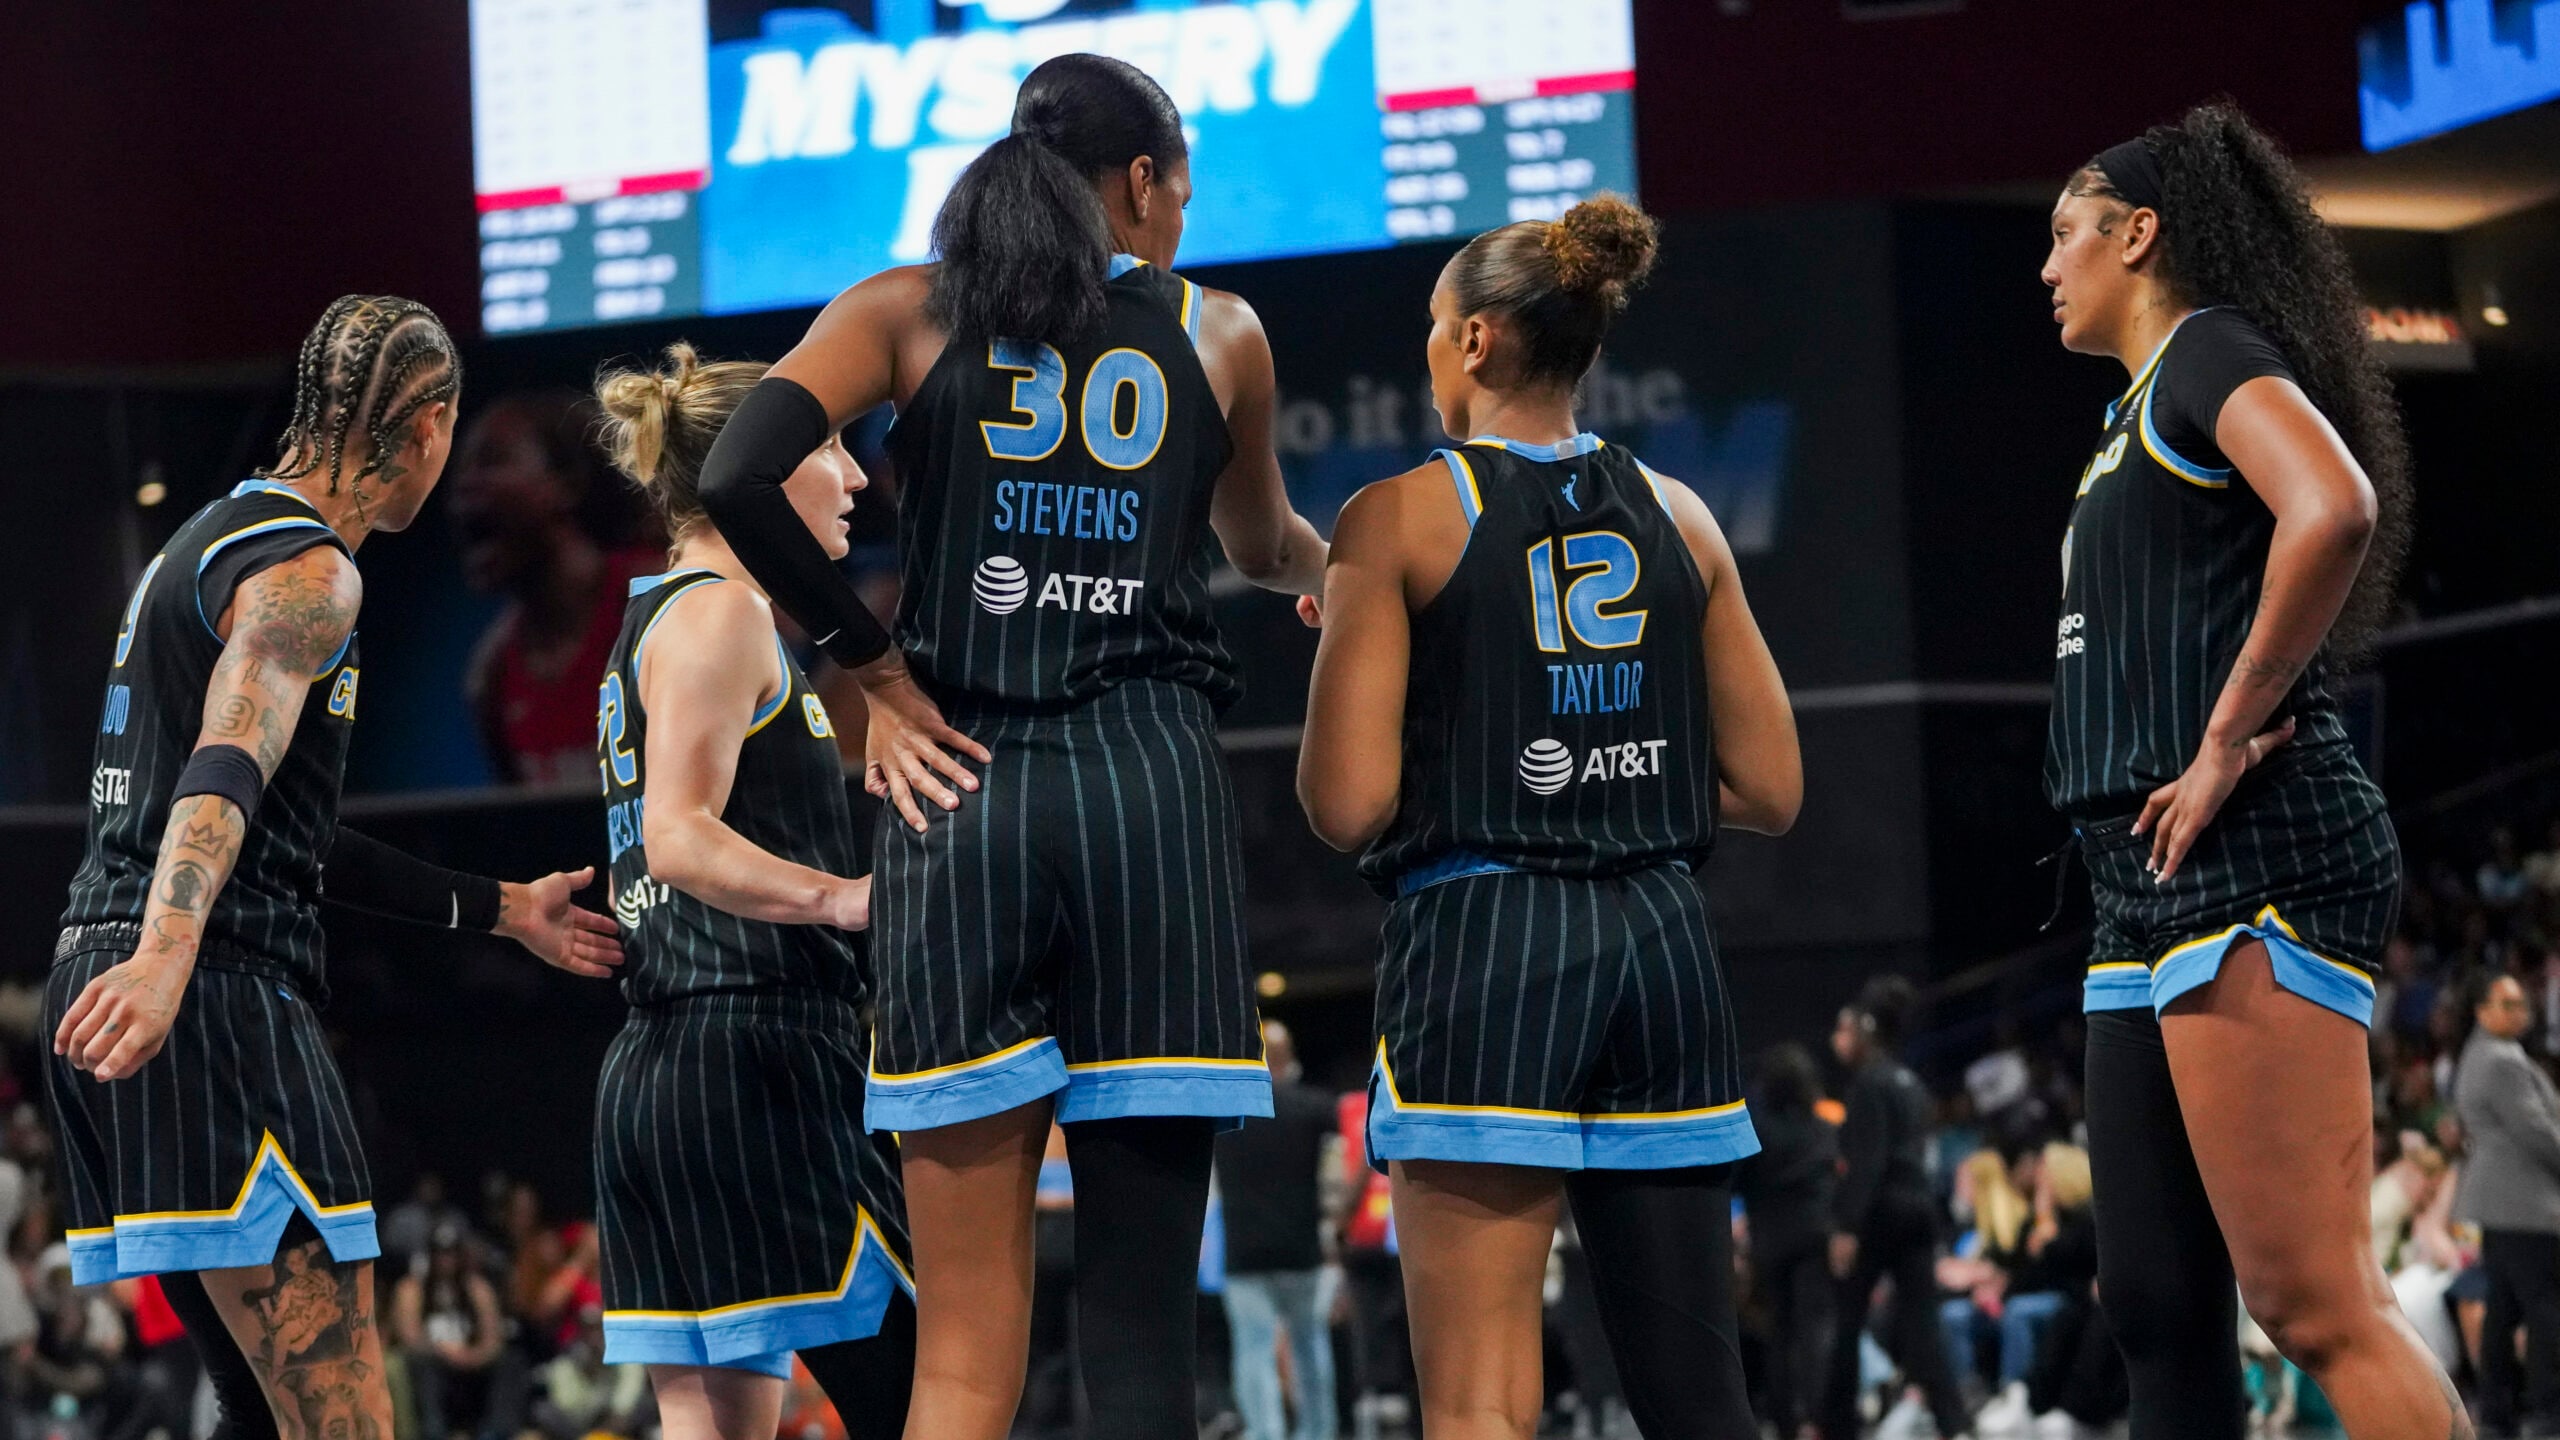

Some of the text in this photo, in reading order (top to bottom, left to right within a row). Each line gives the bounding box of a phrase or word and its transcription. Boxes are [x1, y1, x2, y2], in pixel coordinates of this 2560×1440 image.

[979, 336, 1169, 471] 30
[993, 479, 1140, 542] STEVENS
[1035, 571, 1144, 616] AT&T
[1526, 530, 1649, 653] 12
[1547, 660, 1643, 715] TAYLOR
[1580, 739, 1668, 783] AT&T
